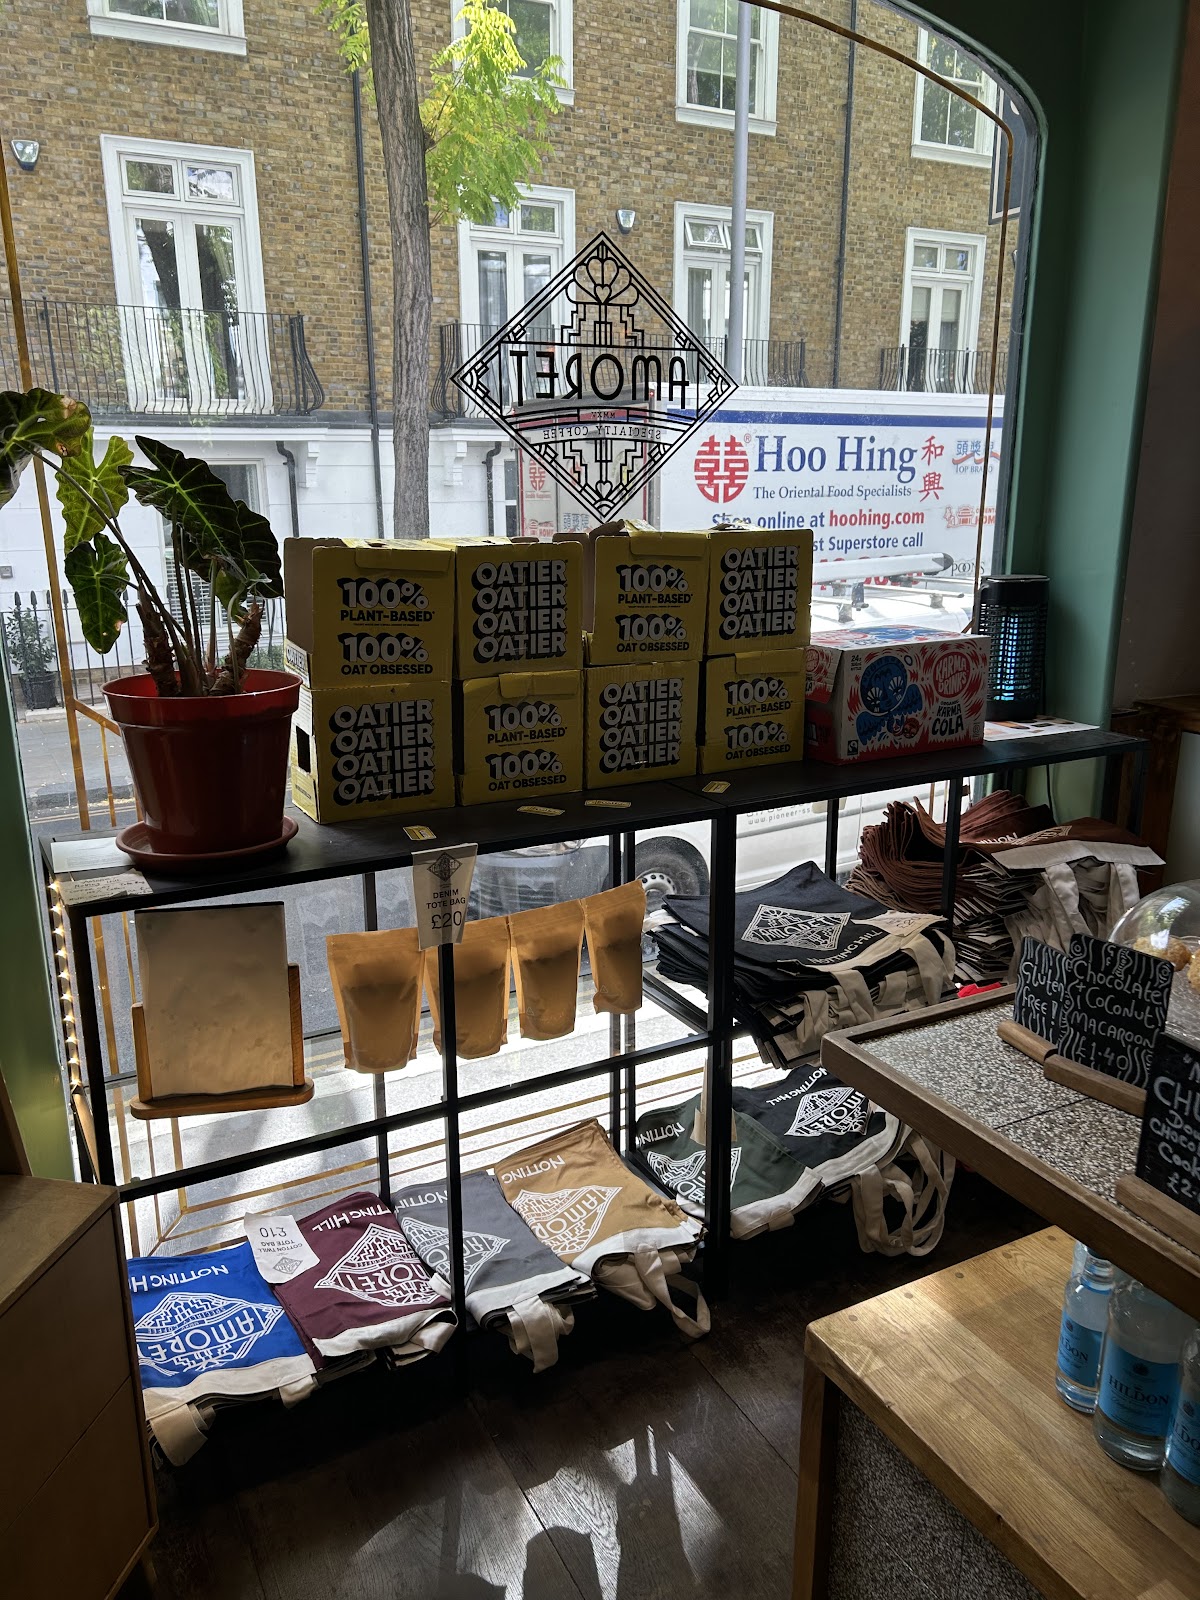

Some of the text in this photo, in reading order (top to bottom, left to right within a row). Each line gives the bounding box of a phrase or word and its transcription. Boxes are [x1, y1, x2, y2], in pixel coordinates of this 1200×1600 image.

[754, 435, 917, 483] Hoo Hing
[956, 440, 994, 456] 頭獎
[918, 435, 944, 502] 和興
[970, 465, 993, 473] BRAD
[754, 484, 912, 500] The Oriental Food Specialists
[757, 511, 806, 529] online
[809, 512, 826, 527] at
[829, 509, 925, 529] hoohing.com
[828, 535, 900, 554] Superstore
[902, 532, 924, 547] call
[616, 565, 689, 593] 100%
[338, 578, 429, 609] 100%
[616, 614, 687, 642] 100%
[338, 633, 429, 663] 100%
[616, 640, 690, 653] OAT OBSESSED
[341, 664, 433, 676] OAT OBSESSED
[724, 677, 789, 706] 100%
[484, 701, 562, 732] 100%
[937, 703, 962, 717] KARMA
[724, 721, 788, 750] 100%
[932, 718, 964, 737] COLA
[484, 748, 563, 779] 100%
[725, 744, 791, 761] OAT OBSESSED
[488, 774, 567, 792] OAT OBSESSED
[426, 897, 466, 909] TOTE BAG
[433, 889, 459, 899] DENIM
[431, 911, 462, 930] £20
[855, 928, 883, 951] HILL
[765, 1093, 790, 1107] HILL
[501, 1154, 566, 1185] NOTTING
[312, 1212, 350, 1231] HILL
[532, 1193, 599, 1240] AMOR
[259, 1227, 287, 1238] £10
[150, 1264, 230, 1288] NOTTING
[147, 1309, 255, 1361] AMORE
[1109, 1374, 1169, 1406] HILDON
